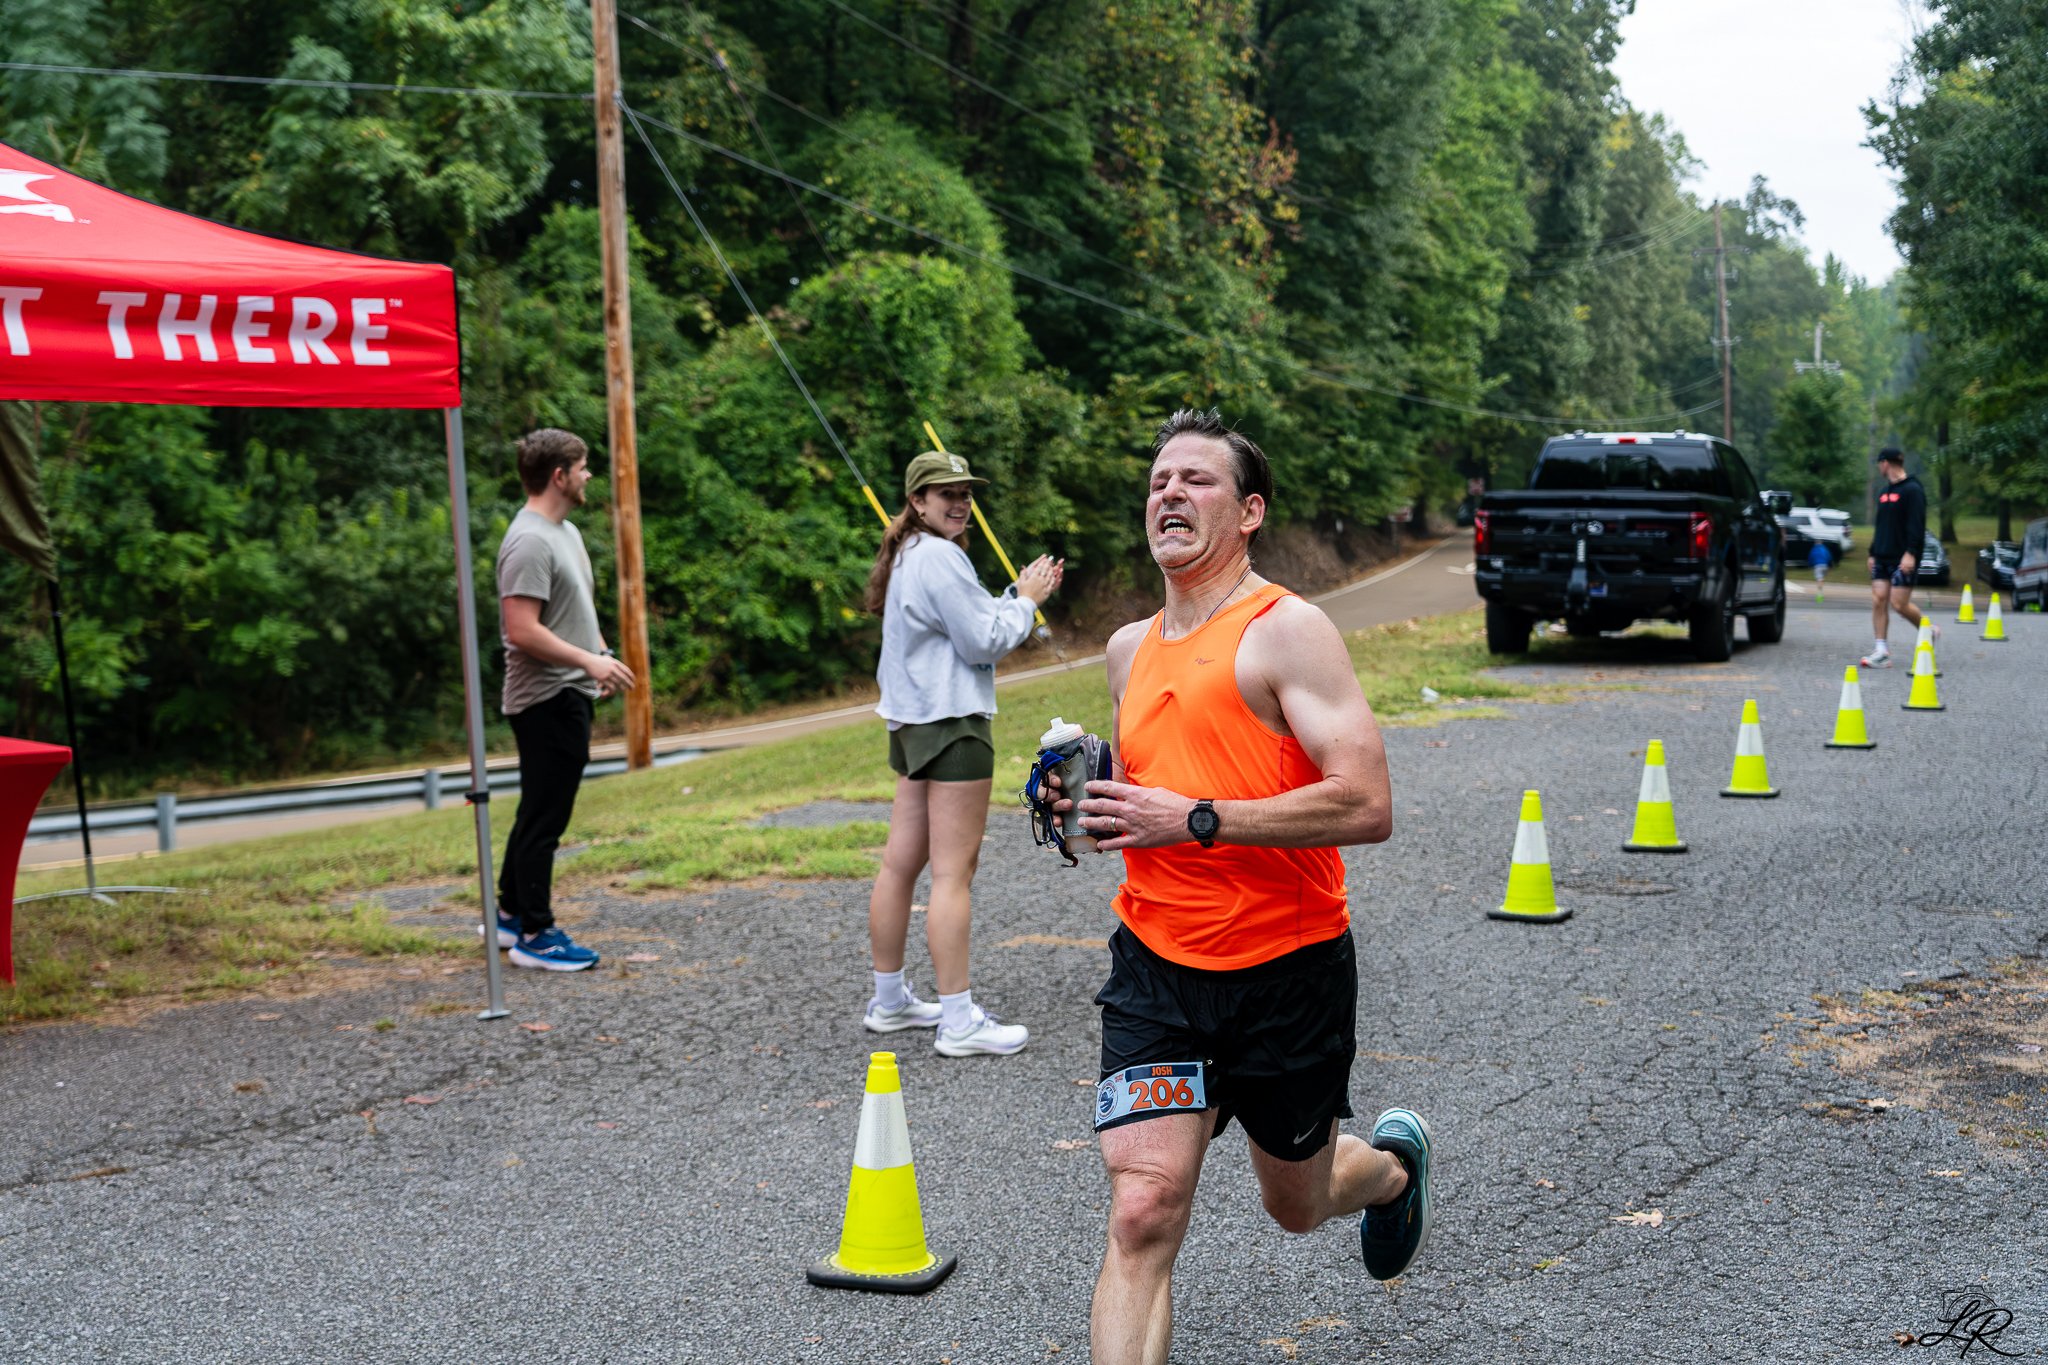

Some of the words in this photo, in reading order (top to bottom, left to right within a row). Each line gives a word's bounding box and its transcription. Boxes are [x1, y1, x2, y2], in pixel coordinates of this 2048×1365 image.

[97, 292, 391, 366] THERE
[1151, 1066, 1173, 1076] JOSH
[1128, 1078, 1194, 1111] 206
